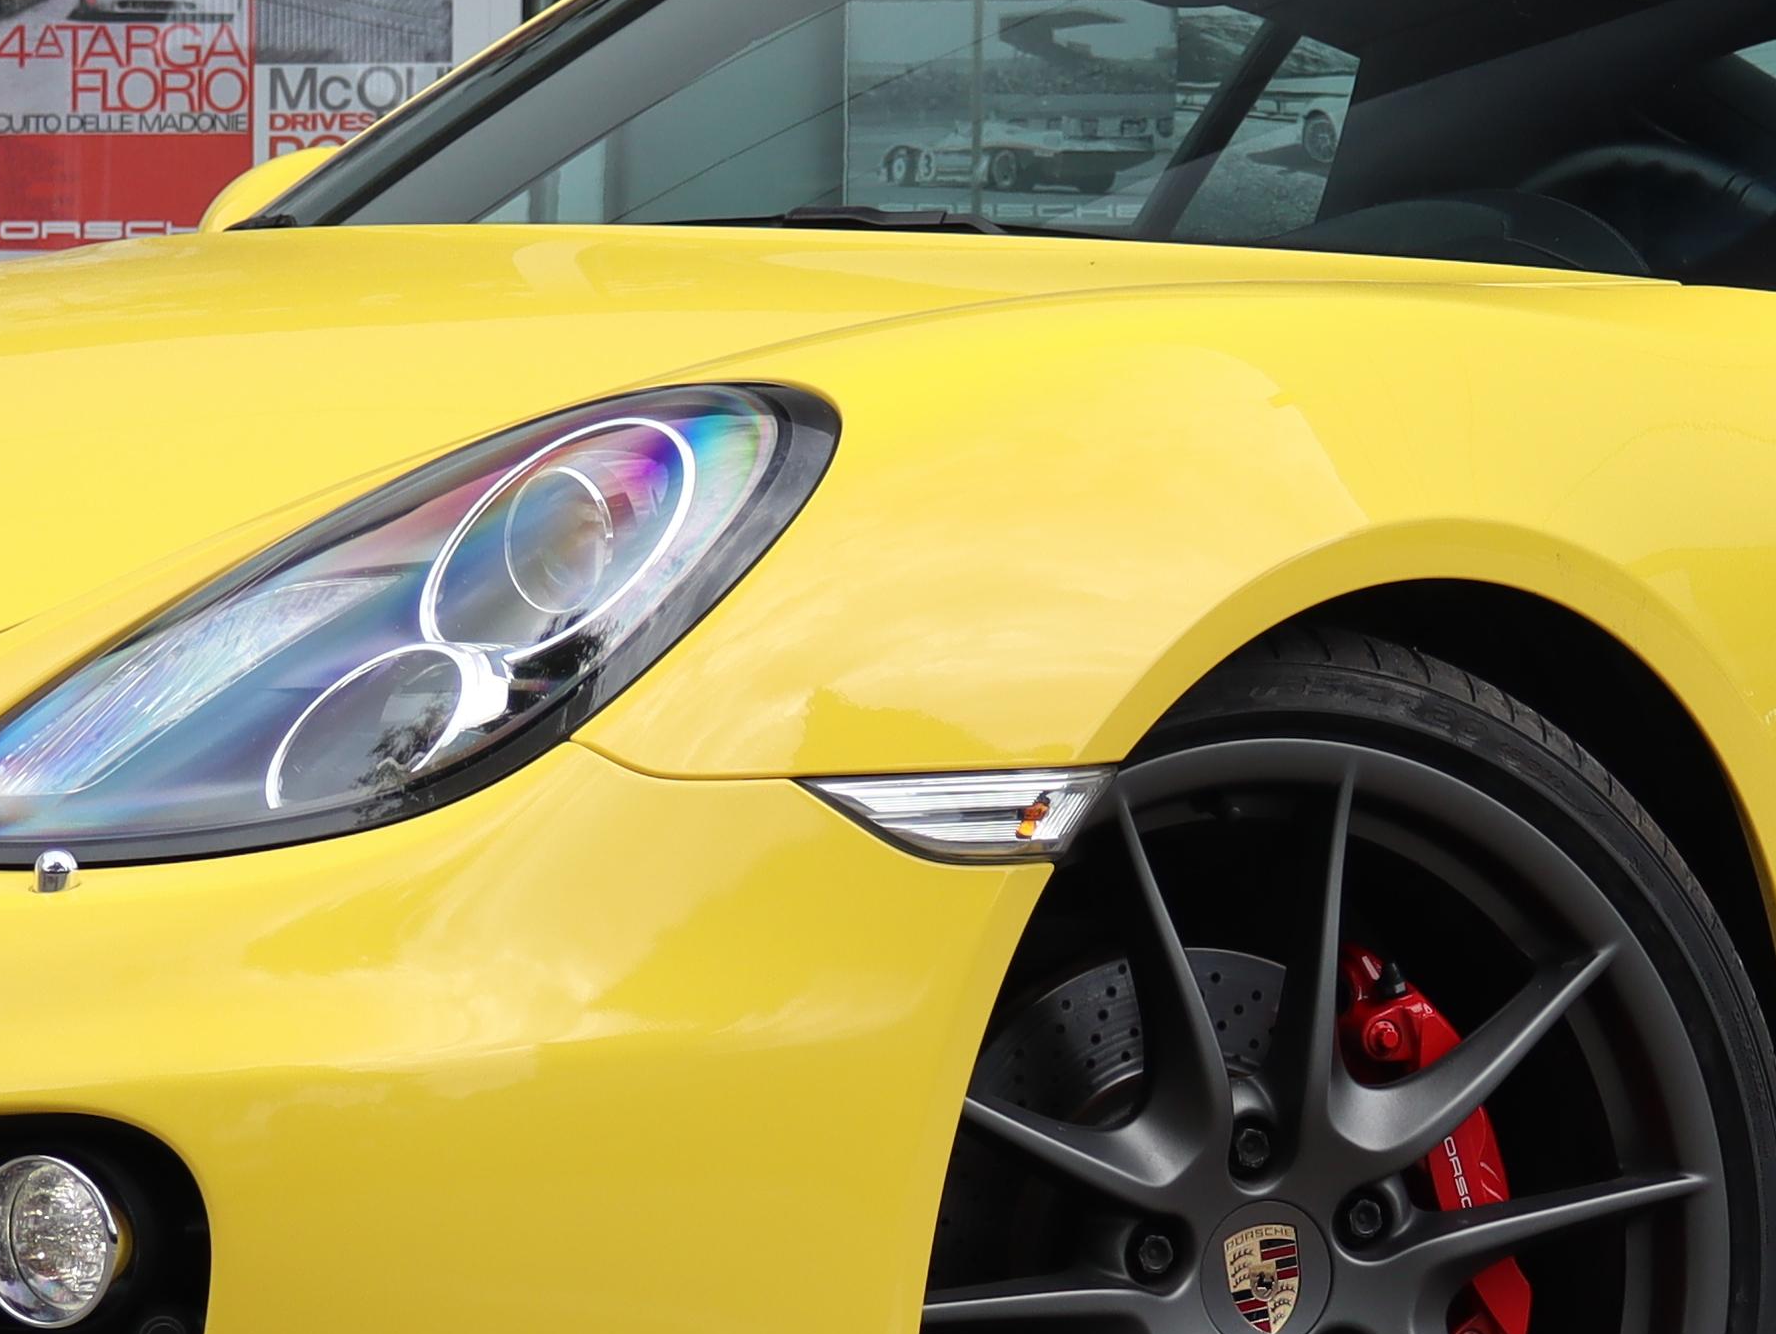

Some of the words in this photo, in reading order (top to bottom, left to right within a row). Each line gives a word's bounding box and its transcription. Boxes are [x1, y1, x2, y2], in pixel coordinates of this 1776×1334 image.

[55, 23, 248, 69] TARGA
[71, 67, 249, 114] FLORIO
[66, 114, 133, 133] DELLE
[139, 113, 248, 133] MADONIE
[269, 113, 374, 132] DRIVES
[1443, 1135, 1473, 1210] ORSC
[1225, 1227, 1292, 1252] PORSCHE
